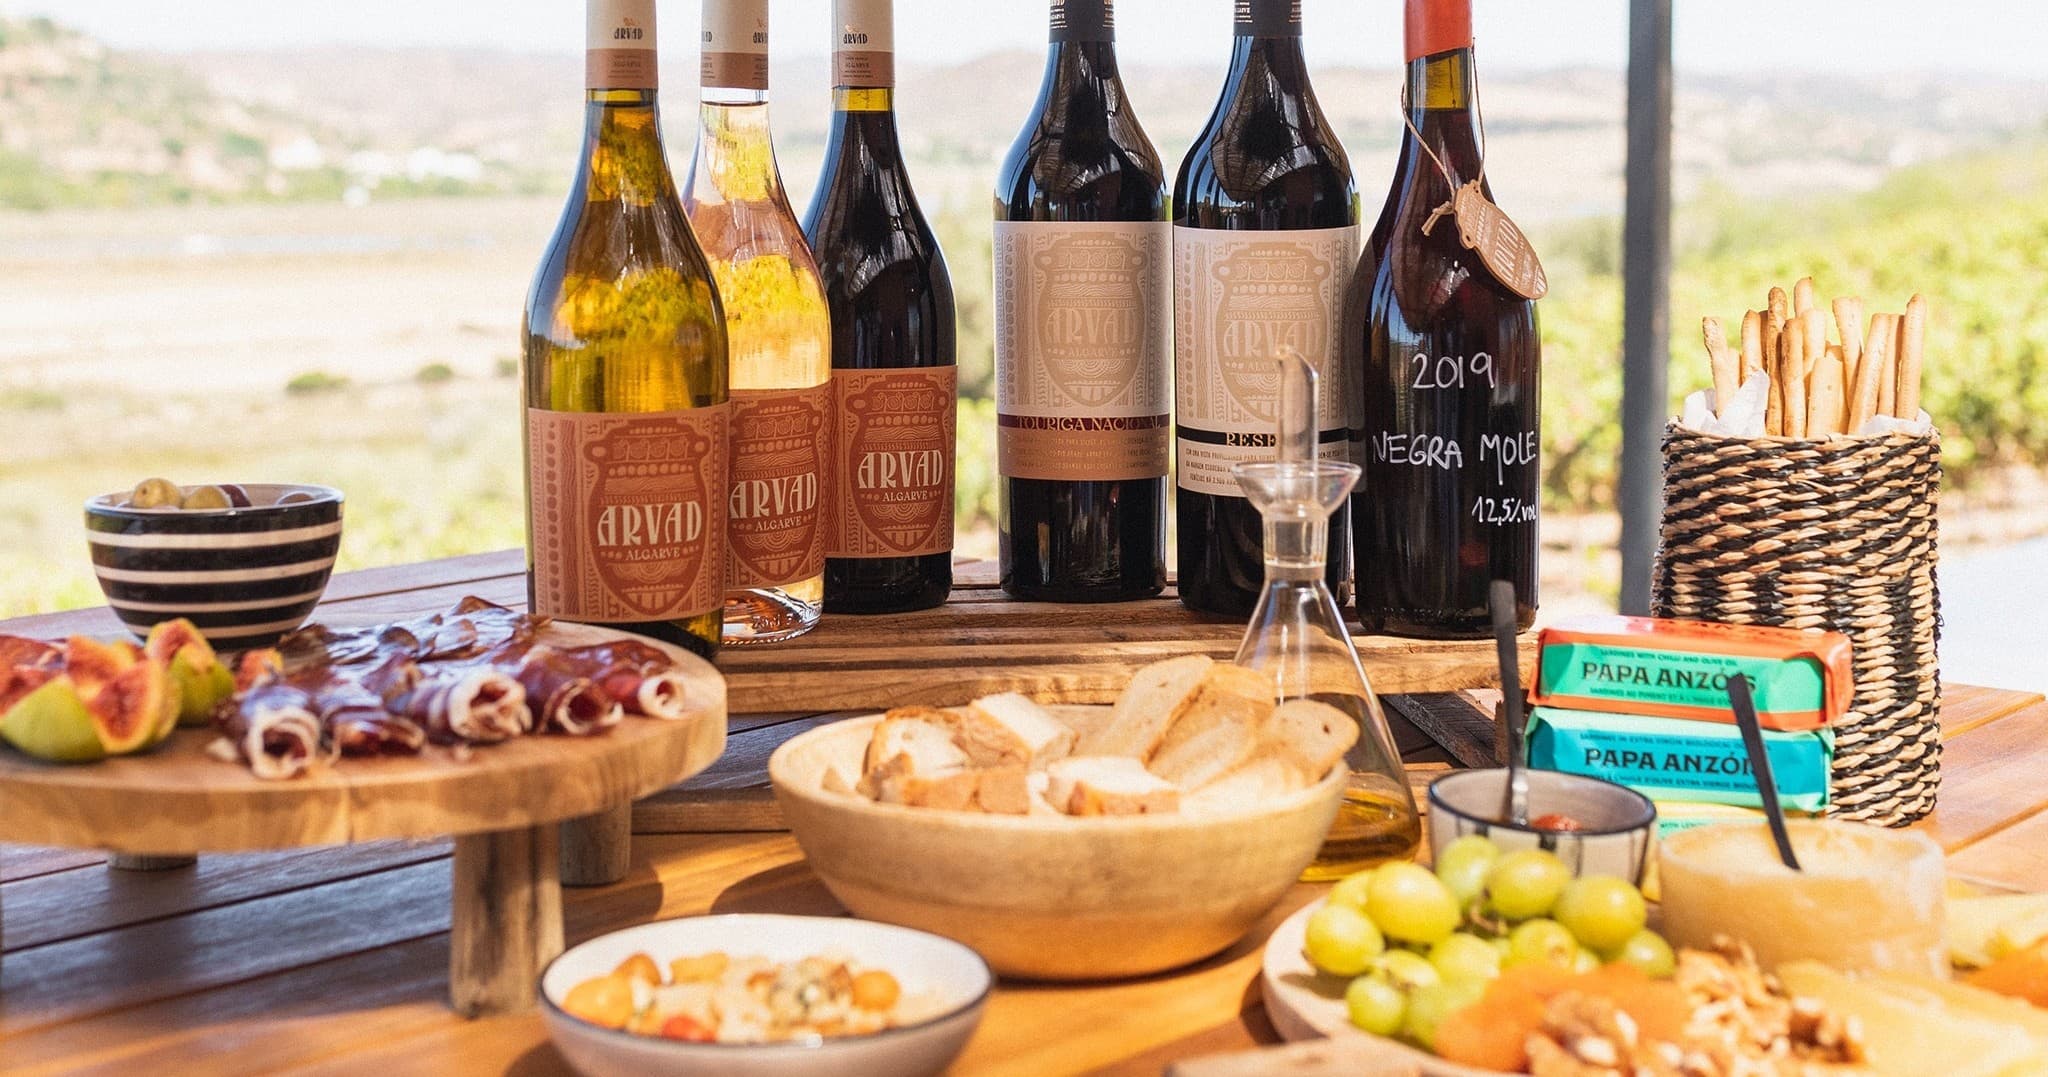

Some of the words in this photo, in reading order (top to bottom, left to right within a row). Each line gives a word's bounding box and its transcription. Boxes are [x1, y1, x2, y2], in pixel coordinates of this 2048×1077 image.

[613, 27, 644, 40] ARVAD
[842, 33, 869, 45] ARVAD
[1044, 308, 1137, 345] ARVAD
[1223, 319, 1321, 358] ARVAD
[1412, 351, 1496, 389] 2019
[1016, 415, 1086, 432] TOURIGA
[1091, 414, 1162, 432] NACIONAL
[857, 449, 943, 489] ARVAD
[1372, 430, 1463, 470] NEGRA
[1479, 430, 1537, 486] MOLE
[728, 471, 818, 520] ARVAD
[882, 489, 929, 502] ALGARVE
[597, 500, 702, 547] ARVAD
[755, 514, 802, 533] ALGARVE
[625, 546, 680, 562] ALGARVE
[1582, 661, 1651, 686] PAPA
[1656, 667, 1757, 692] ANZÓS
[1584, 748, 1657, 771] PAPA
[1664, 753, 1754, 776] ANZÓI
